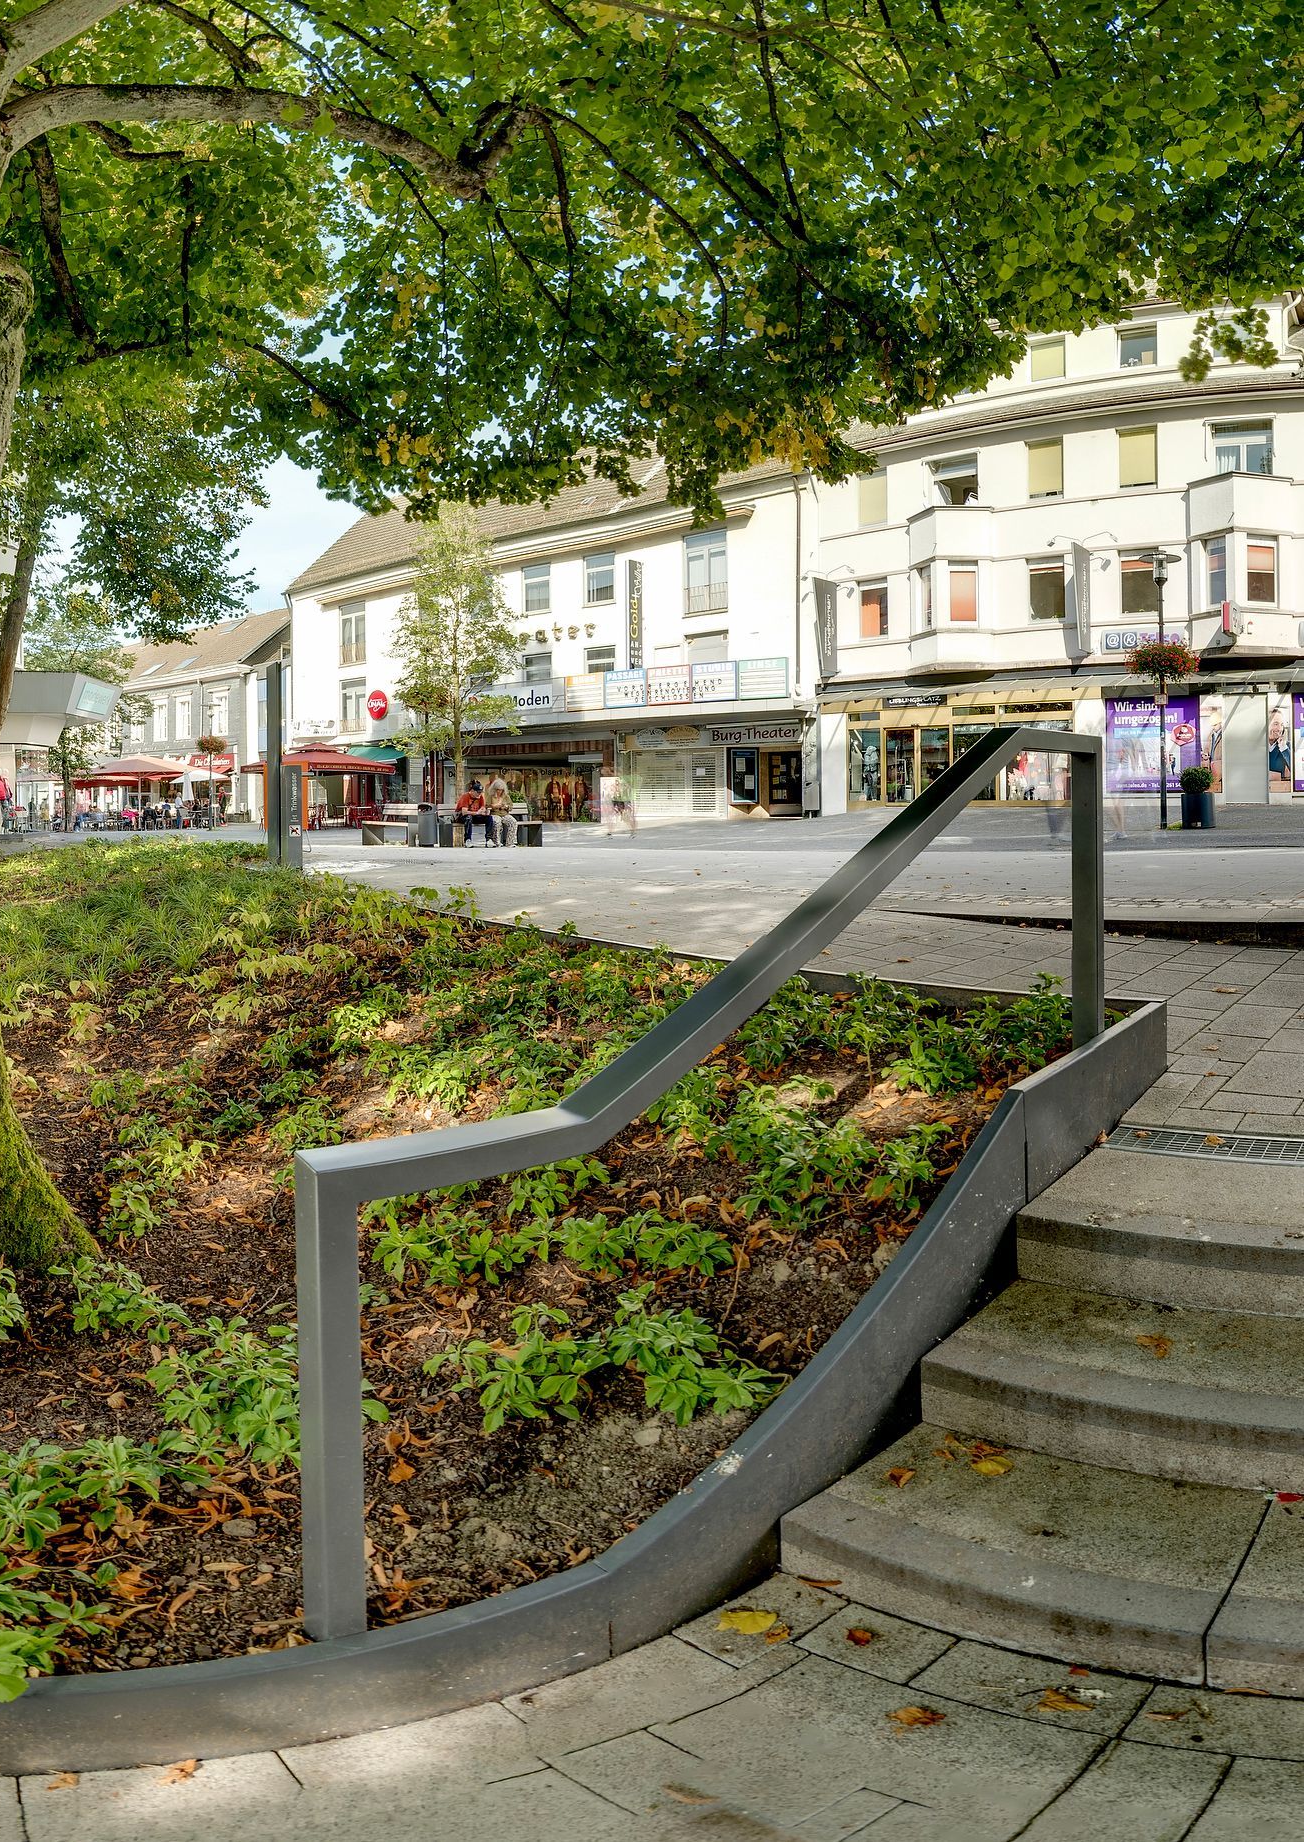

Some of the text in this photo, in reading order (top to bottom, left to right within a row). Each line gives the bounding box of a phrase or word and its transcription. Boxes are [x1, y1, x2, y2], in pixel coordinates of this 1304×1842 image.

[606, 669, 644, 681] PASSAGE
[1114, 701, 1135, 712] Wir
[1114, 713, 1178, 727] umgezogn!
[712, 727, 799, 743] Burg-Theater
[290, 772, 298, 812] Trinkwasser
